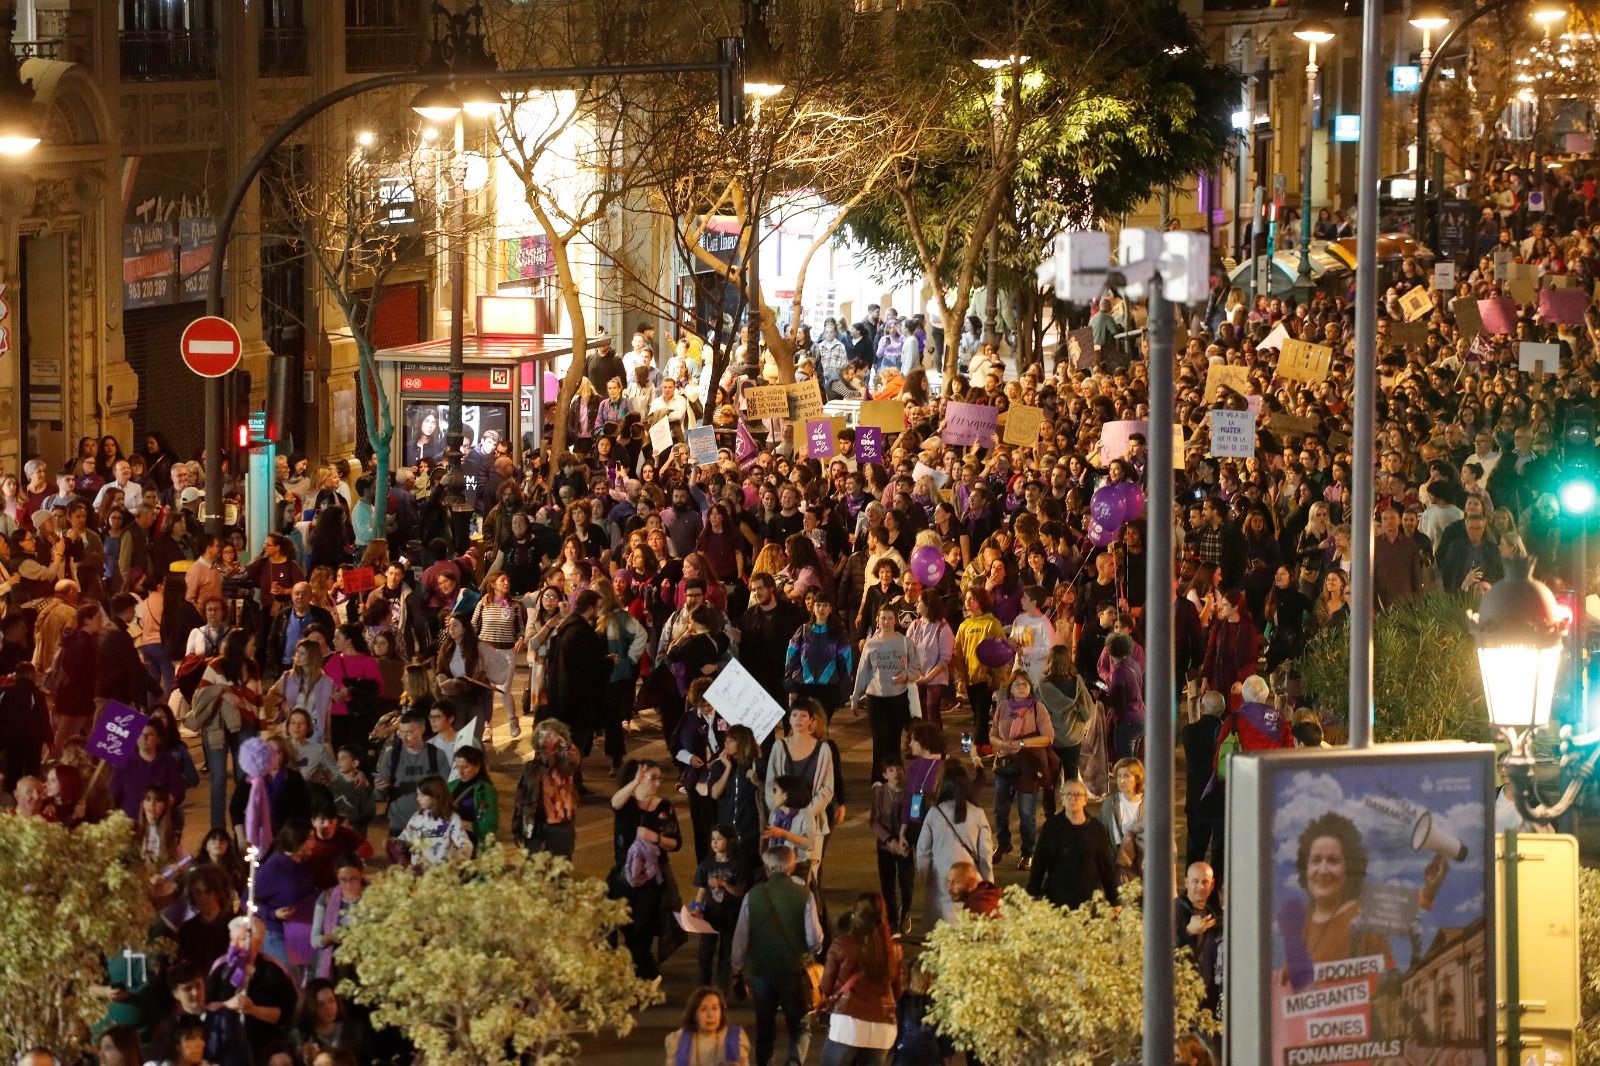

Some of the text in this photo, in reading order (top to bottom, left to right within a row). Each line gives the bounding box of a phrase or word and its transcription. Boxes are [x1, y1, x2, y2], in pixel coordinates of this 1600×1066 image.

[128, 283, 140, 299] 963
[143, 281, 154, 298] 210
[1220, 426, 1241, 434] MUJER
[105, 721, 130, 739] 8M
[1317, 959, 1379, 979] #DONES
[1286, 984, 1368, 1014] MIGRANTS
[1309, 1020, 1364, 1039] DONES
[1287, 1040, 1401, 1066] FONAMENTALS
